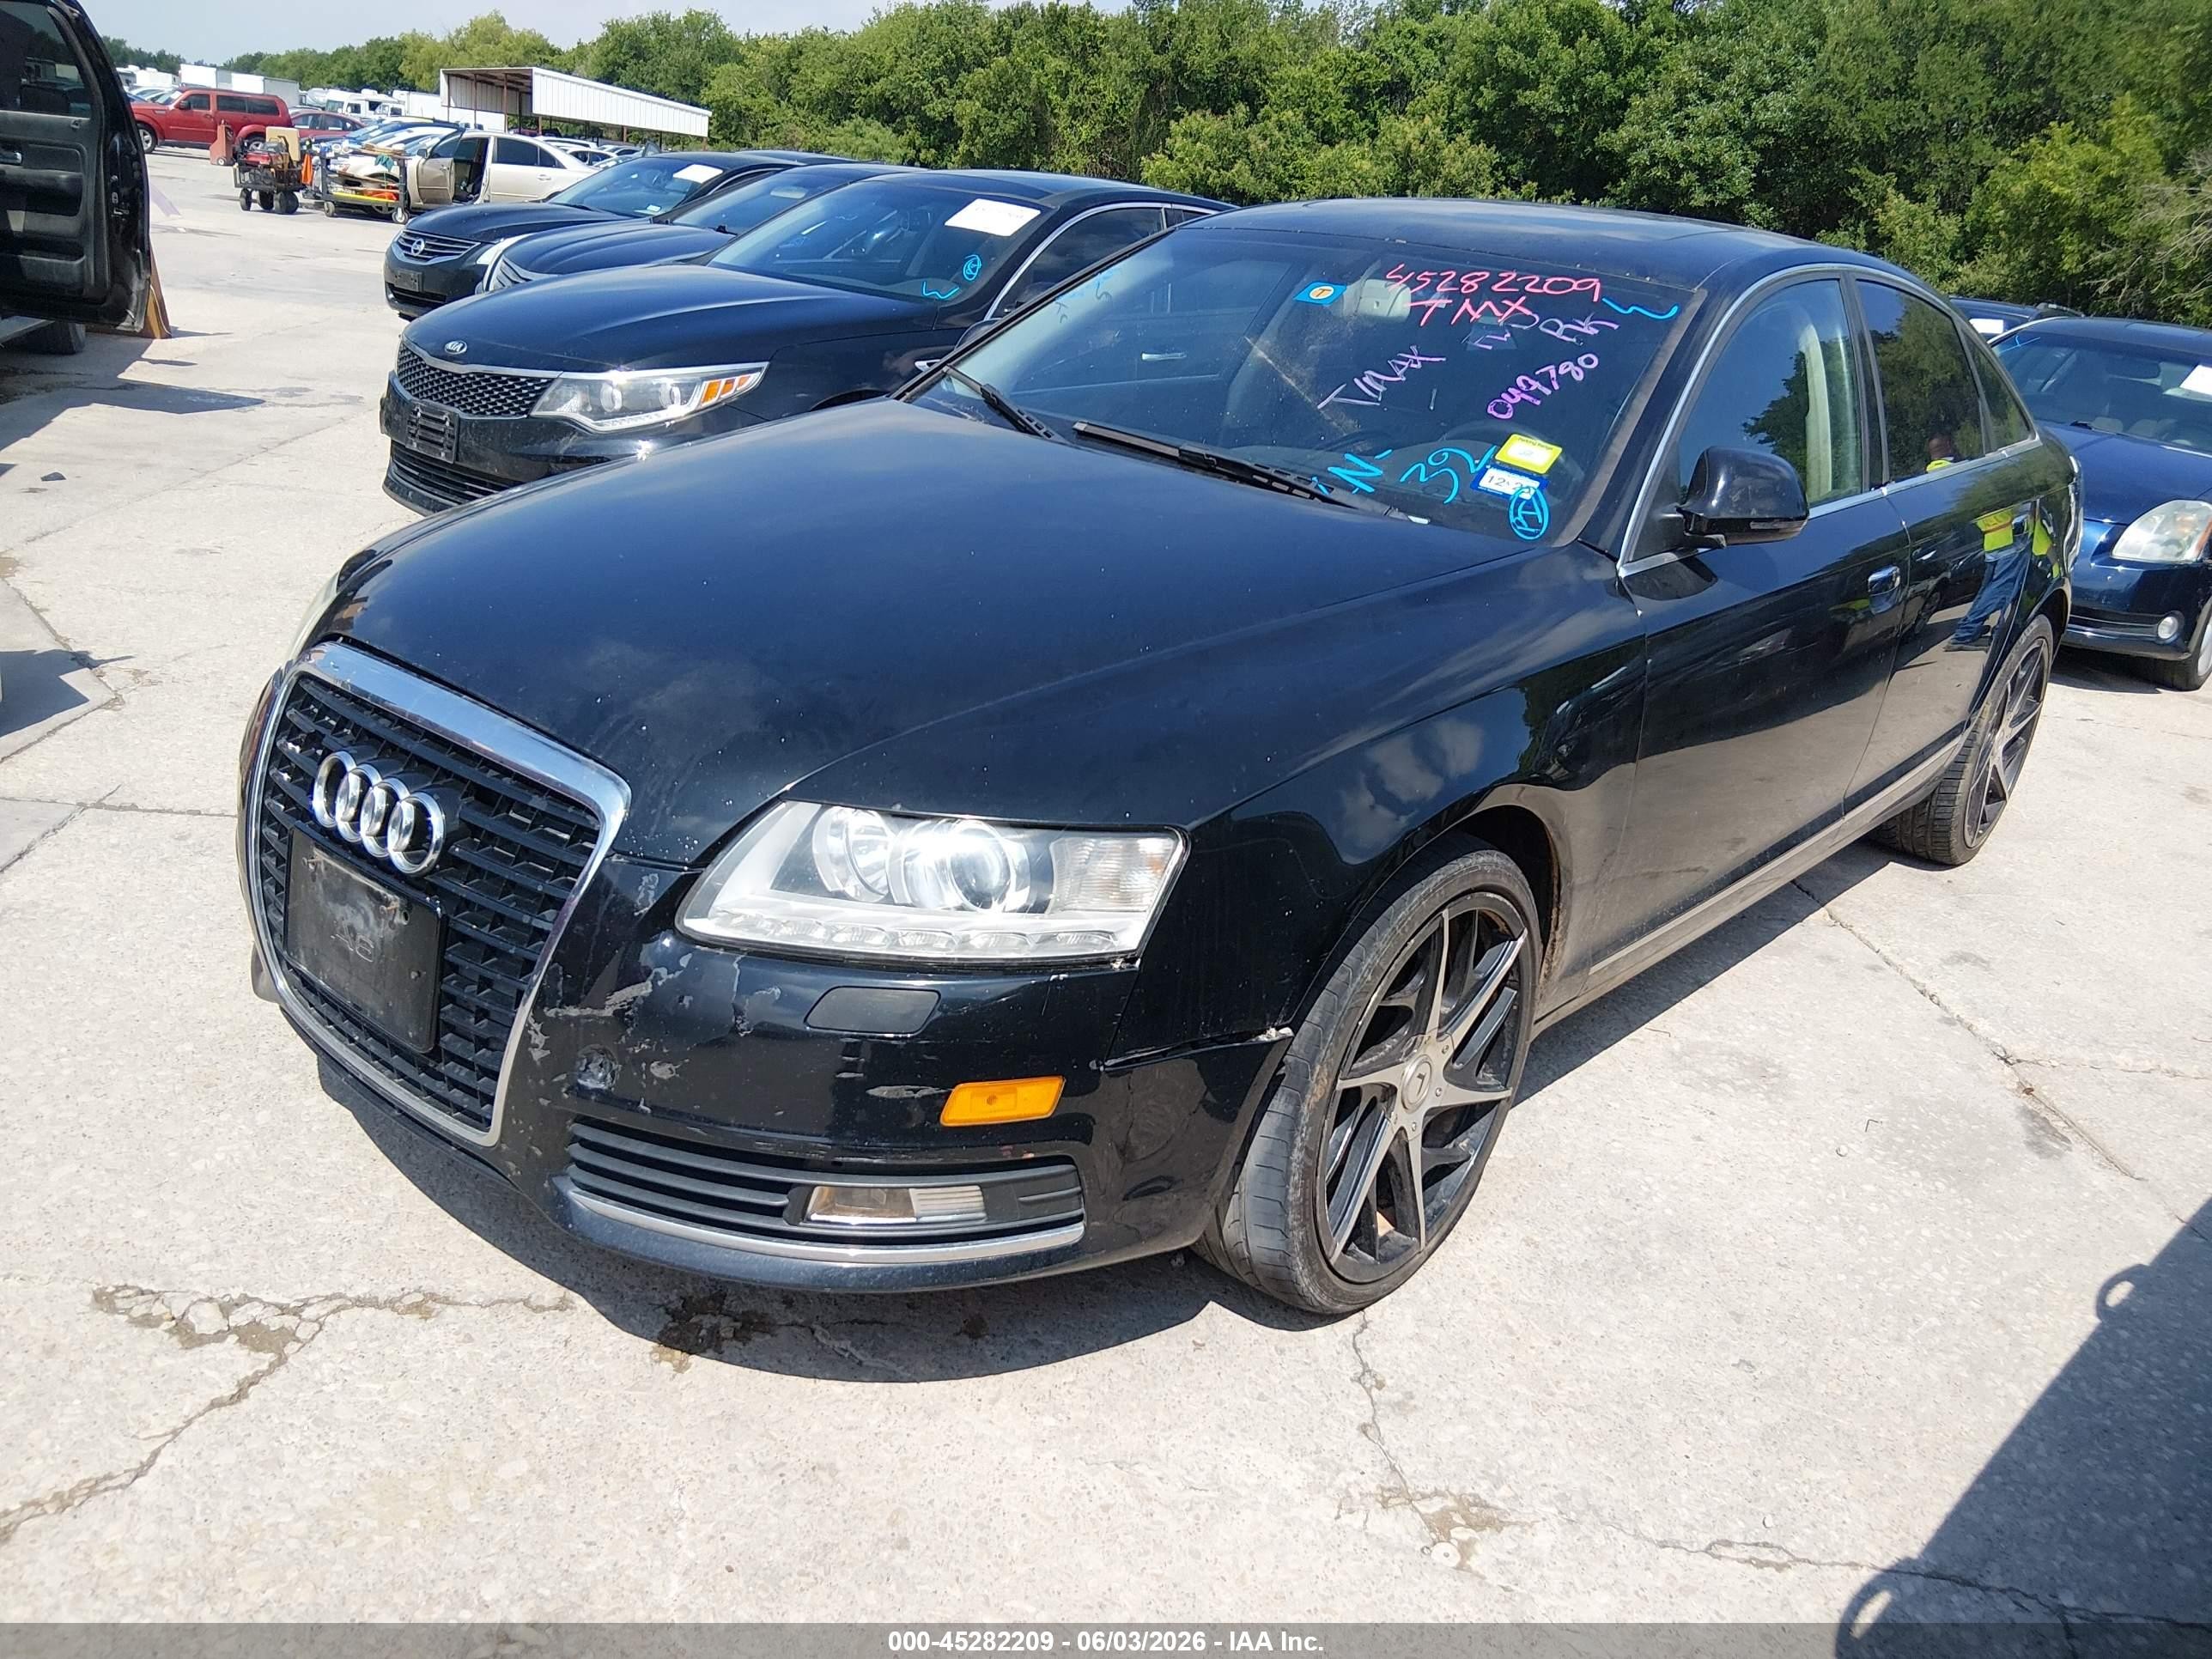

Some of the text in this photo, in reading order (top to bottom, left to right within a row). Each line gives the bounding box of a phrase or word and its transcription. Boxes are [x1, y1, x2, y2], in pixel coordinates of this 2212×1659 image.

[1385, 263, 1601, 302] 45282209
[1408, 295, 1532, 326] TMX
[446, 342, 465, 352] KIA
[1486, 353, 1599, 419] 049780
